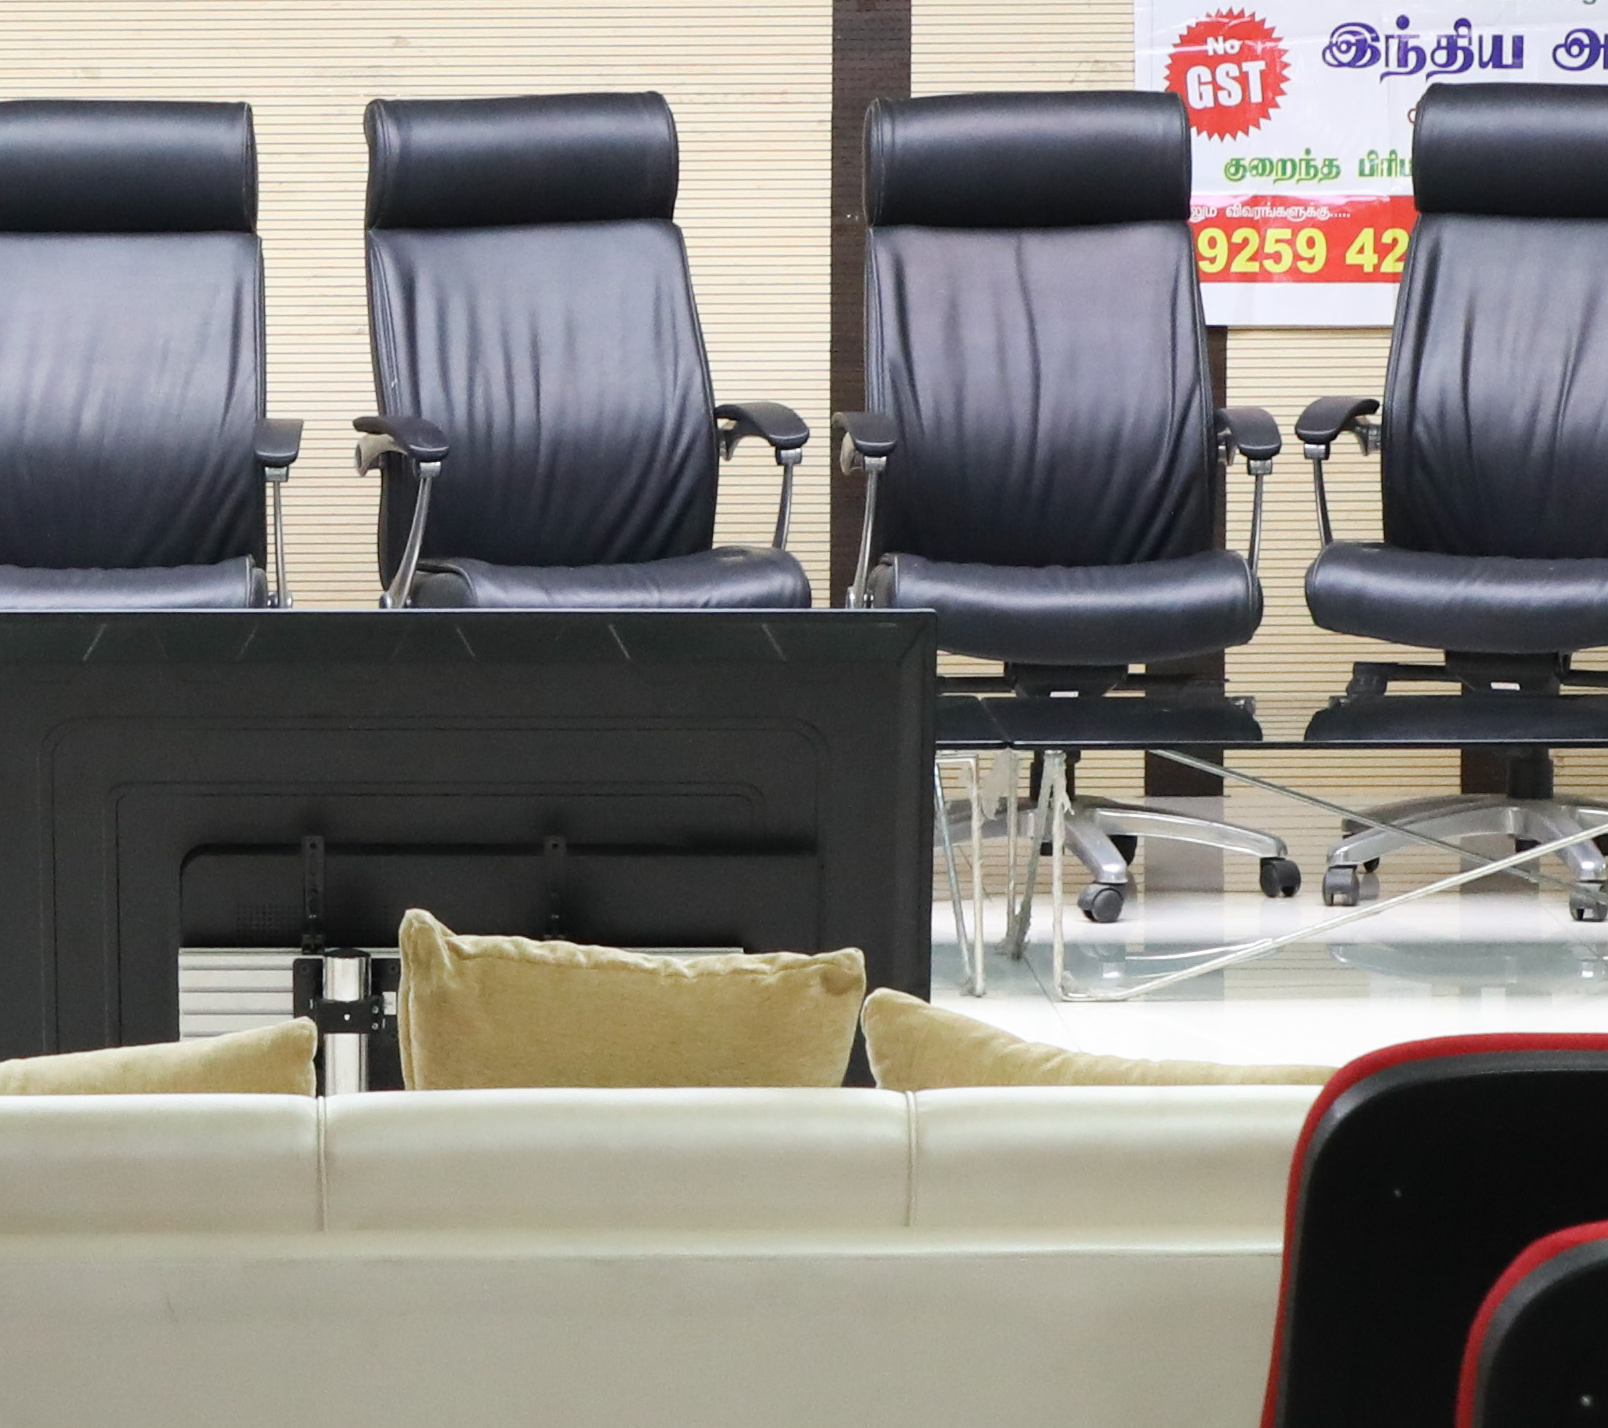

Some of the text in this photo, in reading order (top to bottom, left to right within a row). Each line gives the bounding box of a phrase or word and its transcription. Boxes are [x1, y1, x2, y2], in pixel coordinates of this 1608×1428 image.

[1206, 36, 1244, 56] No
[1322, 14, 1524, 84] இந்திய
[1185, 60, 1267, 110] GST
[1224, 147, 1342, 185] குறைந்த
[1197, 227, 1328, 274] 9259
